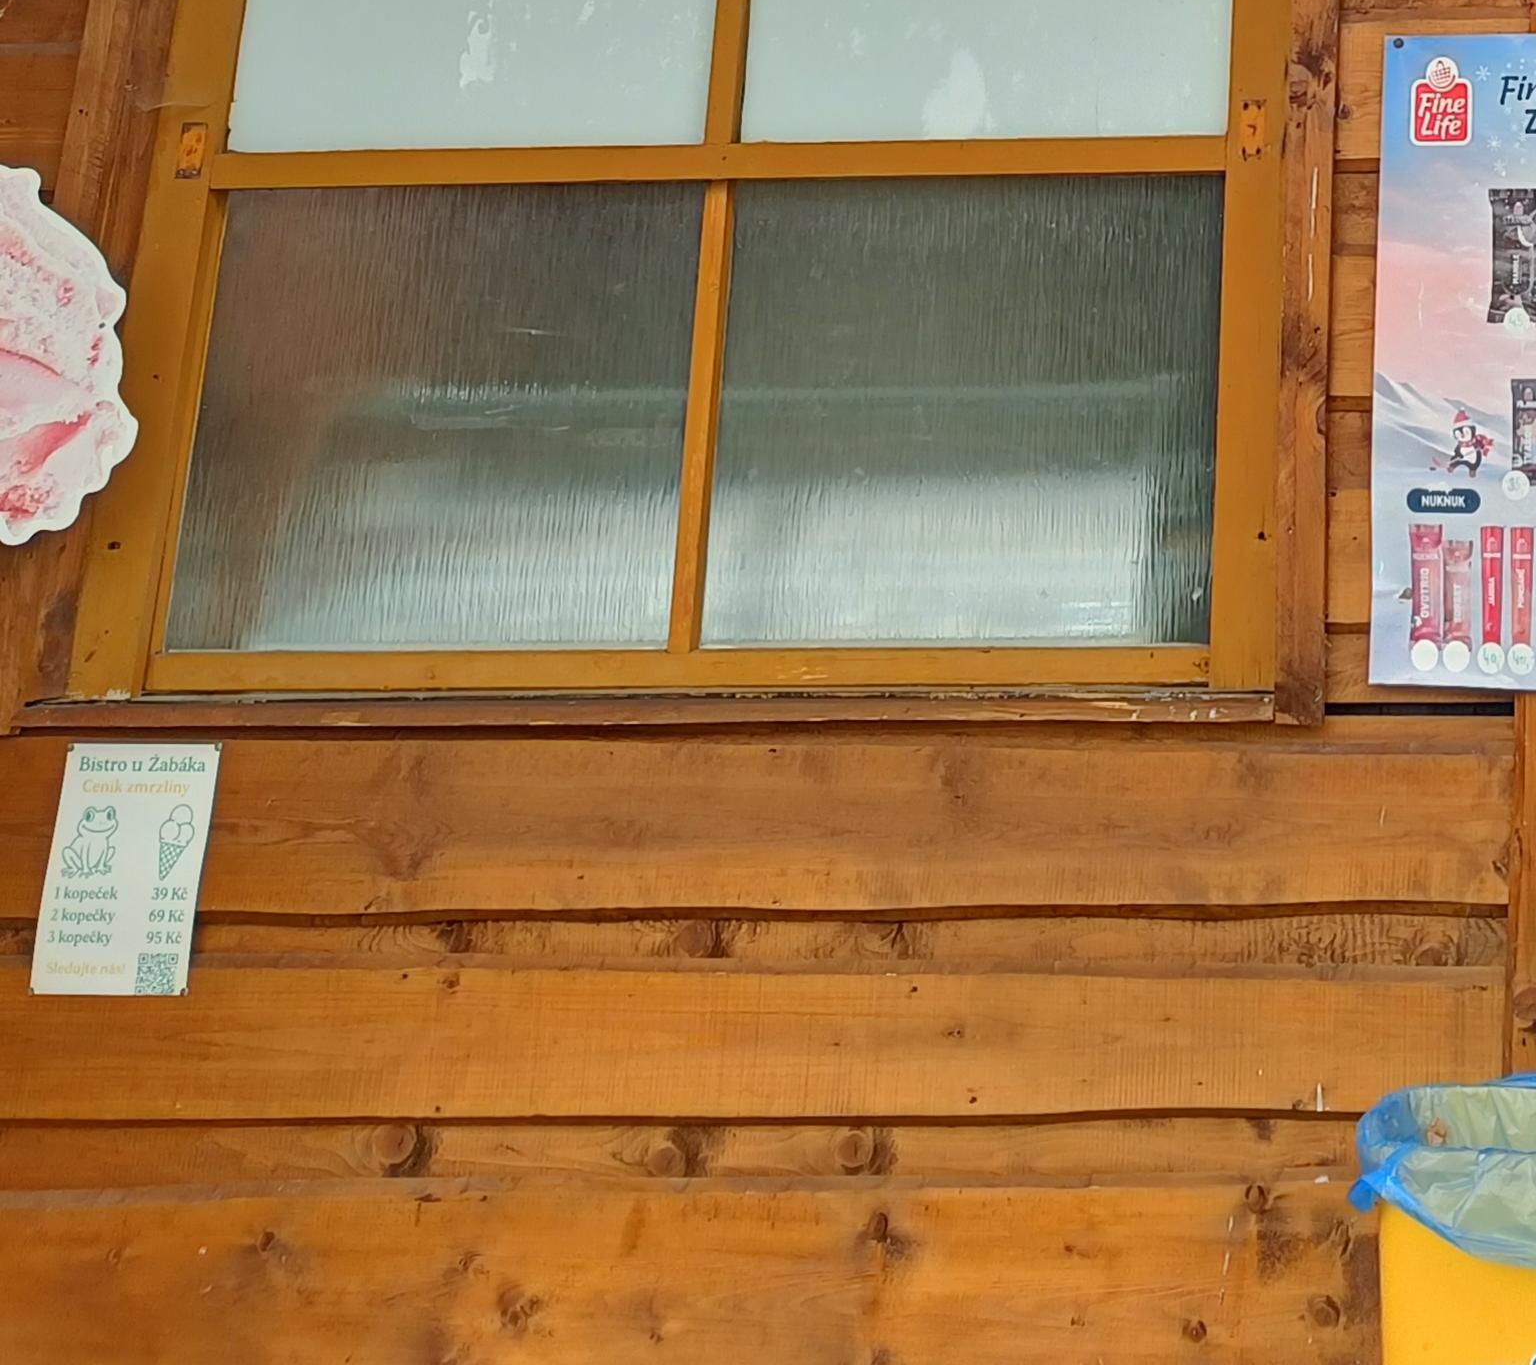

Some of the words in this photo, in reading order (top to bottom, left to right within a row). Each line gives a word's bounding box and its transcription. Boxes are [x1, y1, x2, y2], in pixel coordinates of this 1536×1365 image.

[1417, 92, 1465, 116] Fine
[1420, 113, 1461, 138] Life
[79, 756, 127, 772] Bistro
[132, 761, 142, 772] u
[82, 779, 122, 793] Ceník
[127, 780, 190, 797] zmrzliny
[54, 887, 61, 899] 1
[64, 885, 118, 903] kopeček
[152, 887, 168, 901] 39
[170, 886, 188, 901] Kč
[50, 910, 58, 922] 2
[62, 909, 116, 925] kopečky
[148, 910, 165, 923] 69
[168, 909, 185, 923] Kč
[48, 931, 56, 943] 3
[58, 930, 112, 947] kopečky
[146, 932, 163, 944] 95
[166, 931, 182, 944] Kč
